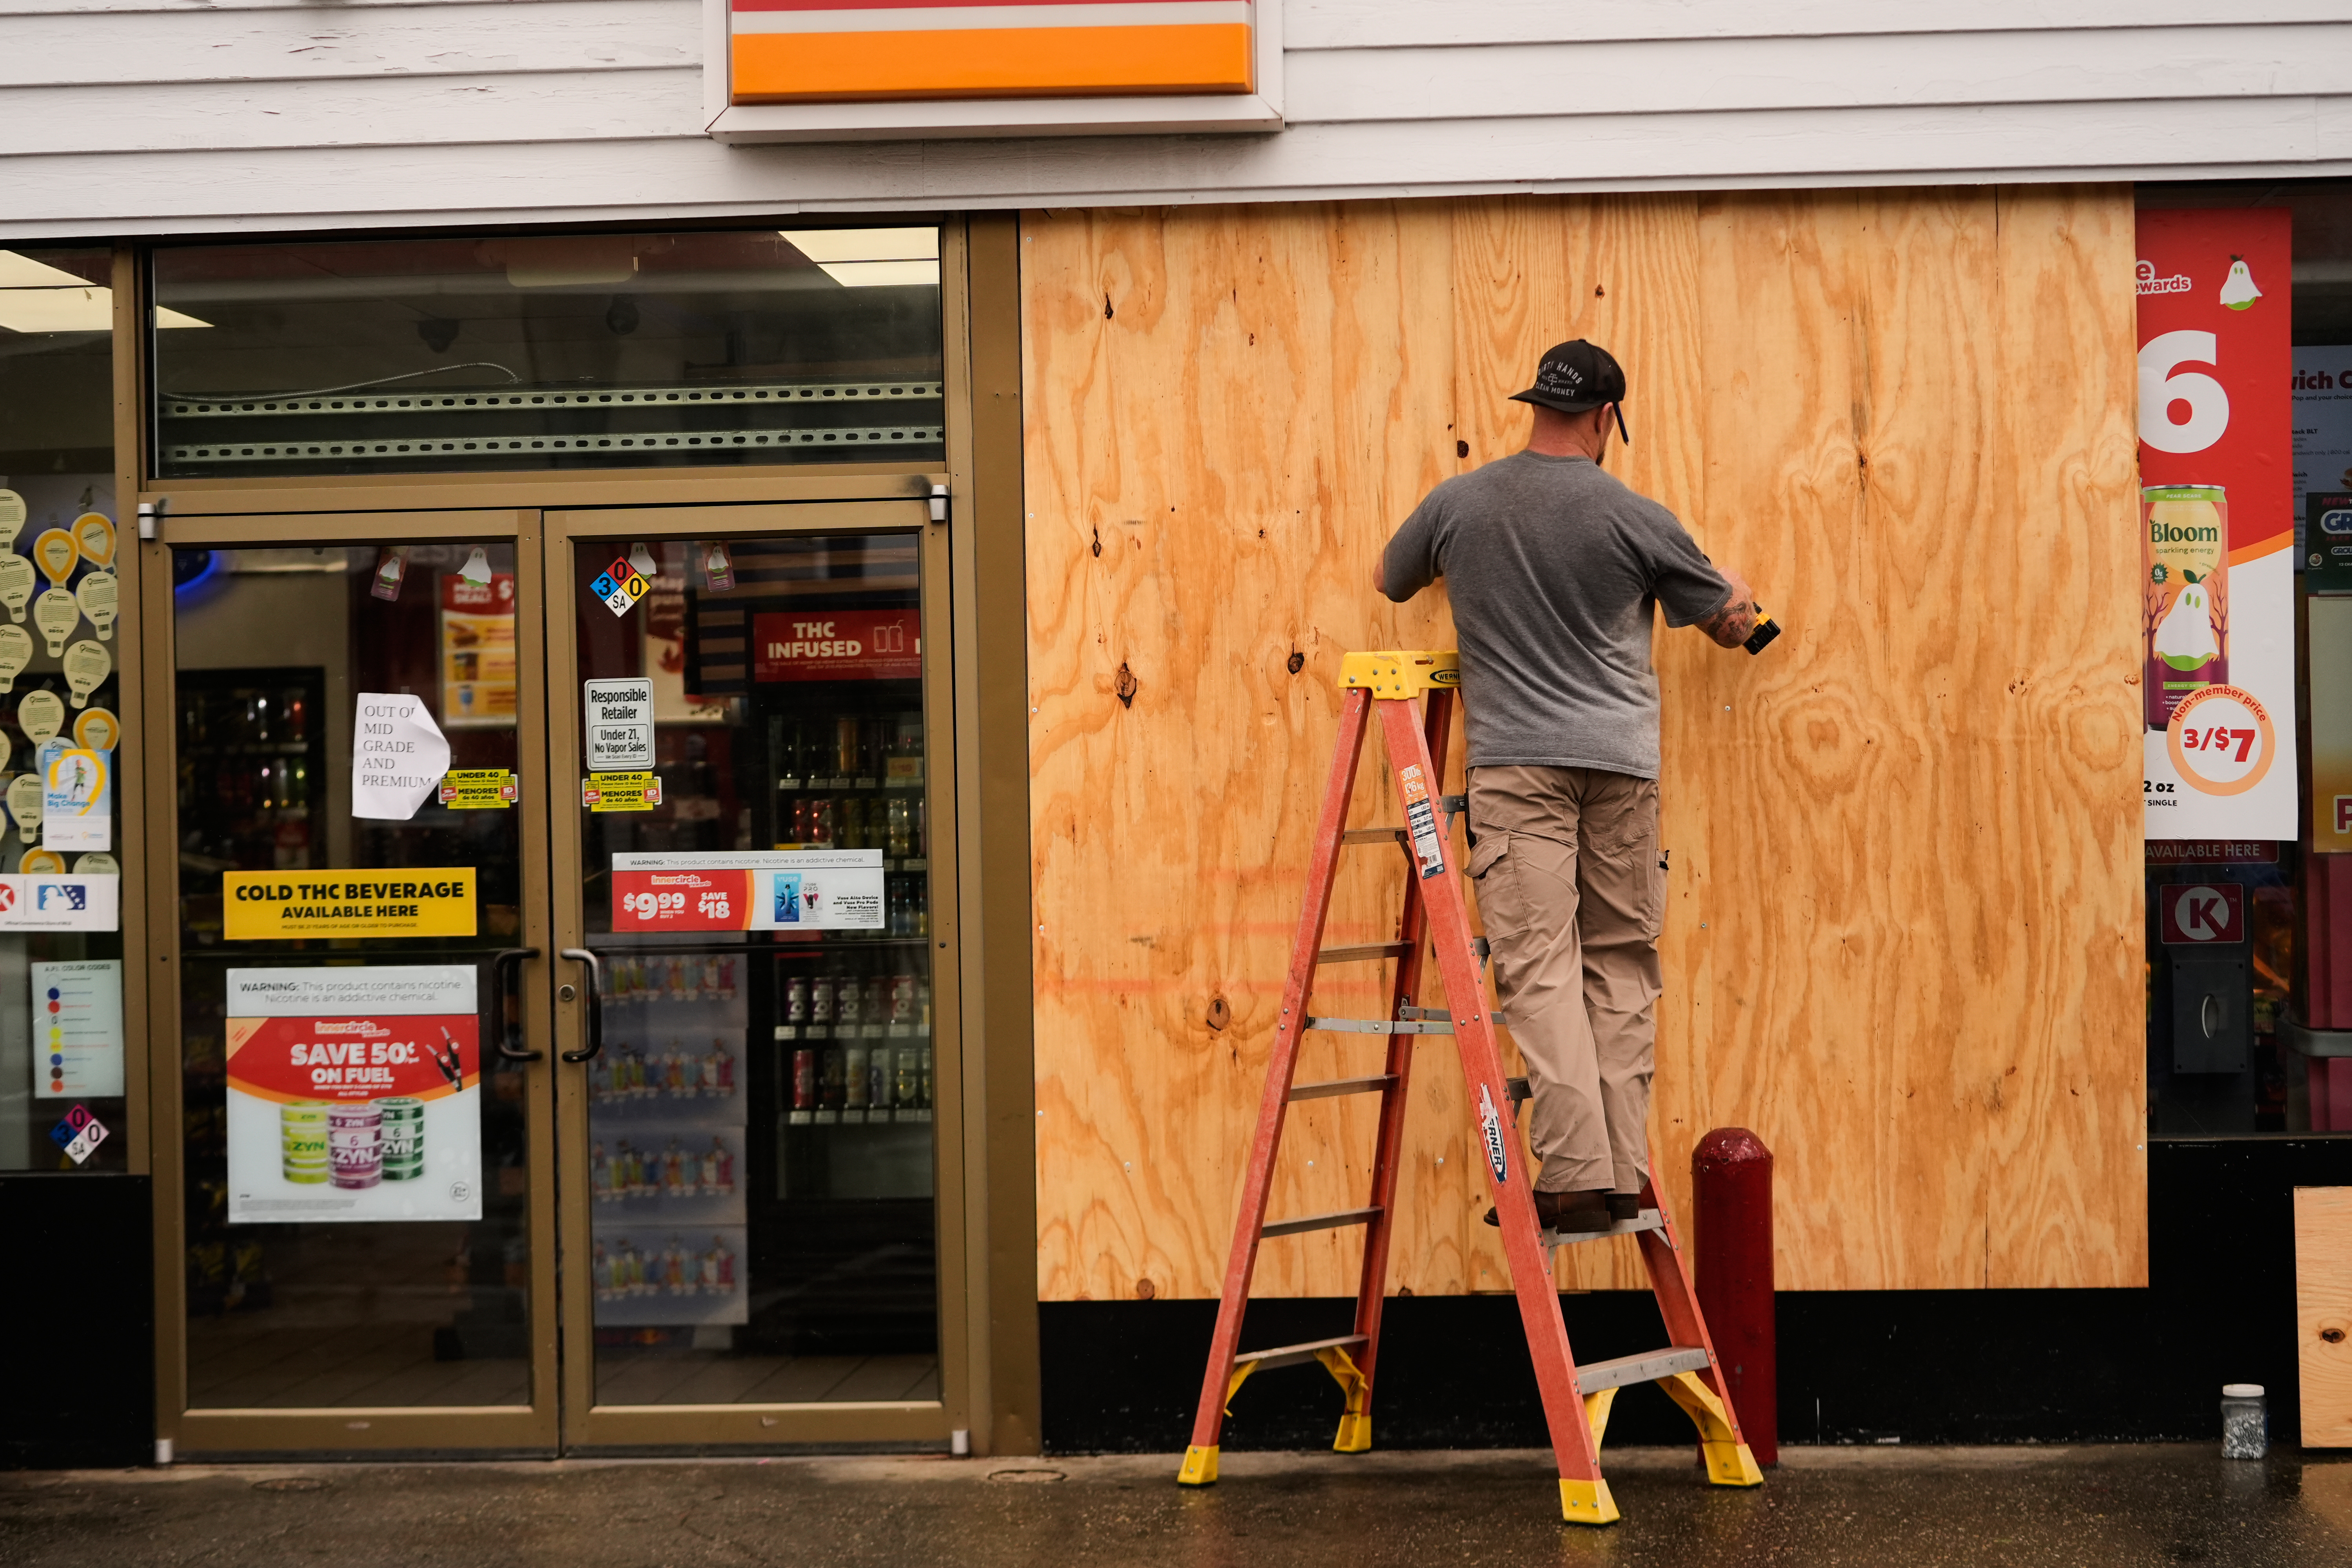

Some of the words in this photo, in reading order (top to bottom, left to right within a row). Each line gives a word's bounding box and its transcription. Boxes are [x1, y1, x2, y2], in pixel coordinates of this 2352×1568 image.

[1538, 361, 1554, 376] DIRTY
[1556, 361, 1583, 384] HANDS
[1536, 381, 1550, 392] CLEAN
[1551, 387, 1575, 397] MONEY
[2137, 330, 2229, 454] 6
[2322, 497, 2348, 506] NEW
[2151, 522, 2218, 543] Bloom
[614, 562, 627, 581] 0
[598, 577, 611, 596] 3
[630, 578, 642, 596] 0
[613, 595, 626, 608] SA
[792, 621, 835, 639] THC
[767, 640, 862, 659] INFUSED
[591, 688, 647, 704] Responsible
[2172, 686, 2243, 722] Non-member
[2242, 696, 2266, 722] price
[365, 706, 396, 717] OUT
[602, 706, 637, 719] Retailer
[364, 723, 393, 734] MID
[601, 729, 626, 740] Under
[628, 728, 639, 741] 21,
[363, 740, 415, 753] GRADE
[595, 743, 604, 753] No
[606, 742, 627, 754] Vapor
[628, 740, 646, 752] Sales
[2184, 726, 2255, 762] 3/$7
[363, 758, 395, 769] AND
[362, 775, 432, 788] PREMIUM
[1405, 781, 1417, 794] 136
[1417, 782, 1425, 790] kg
[2156, 782, 2174, 792] oz
[2145, 844, 2220, 858] AVAILABLE
[2225, 844, 2260, 857] HERE
[652, 875, 700, 884] innercircle
[236, 884, 293, 901] COLD
[298, 884, 339, 900] THC
[345, 882, 464, 899] BEVERAGE
[701, 892, 727, 900] SAVE
[281, 906, 372, 918] AVAILABLE
[376, 905, 419, 916] HERE
[698, 900, 730, 919] $18
[2189, 898, 2224, 937] K
[240, 982, 299, 992] WARNING:
[302, 982, 323, 991] This
[326, 981, 368, 992] product
[371, 981, 416, 990] contains
[418, 980, 464, 989] nicotine.
[265, 995, 309, 1003] Nicotine
[338, 993, 387, 1002] addictive
[389, 991, 439, 1000] chemical.
[316, 1021, 376, 1034] innercircle
[290, 1043, 366, 1066] SAVE
[311, 1068, 342, 1084] ON
[345, 1067, 395, 1083] FUEL
[72, 1108, 85, 1127] 0
[345, 1118, 365, 1127] ZYN
[57, 1124, 70, 1143] 3
[88, 1124, 100, 1142] 0
[394, 1128, 401, 1137] 6
[292, 1142, 325, 1151] ZYN
[350, 1136, 358, 1146] 6
[381, 1139, 414, 1154] ZYN
[1488, 1118, 1502, 1166] ERNER
[336, 1148, 373, 1164] ZYN
